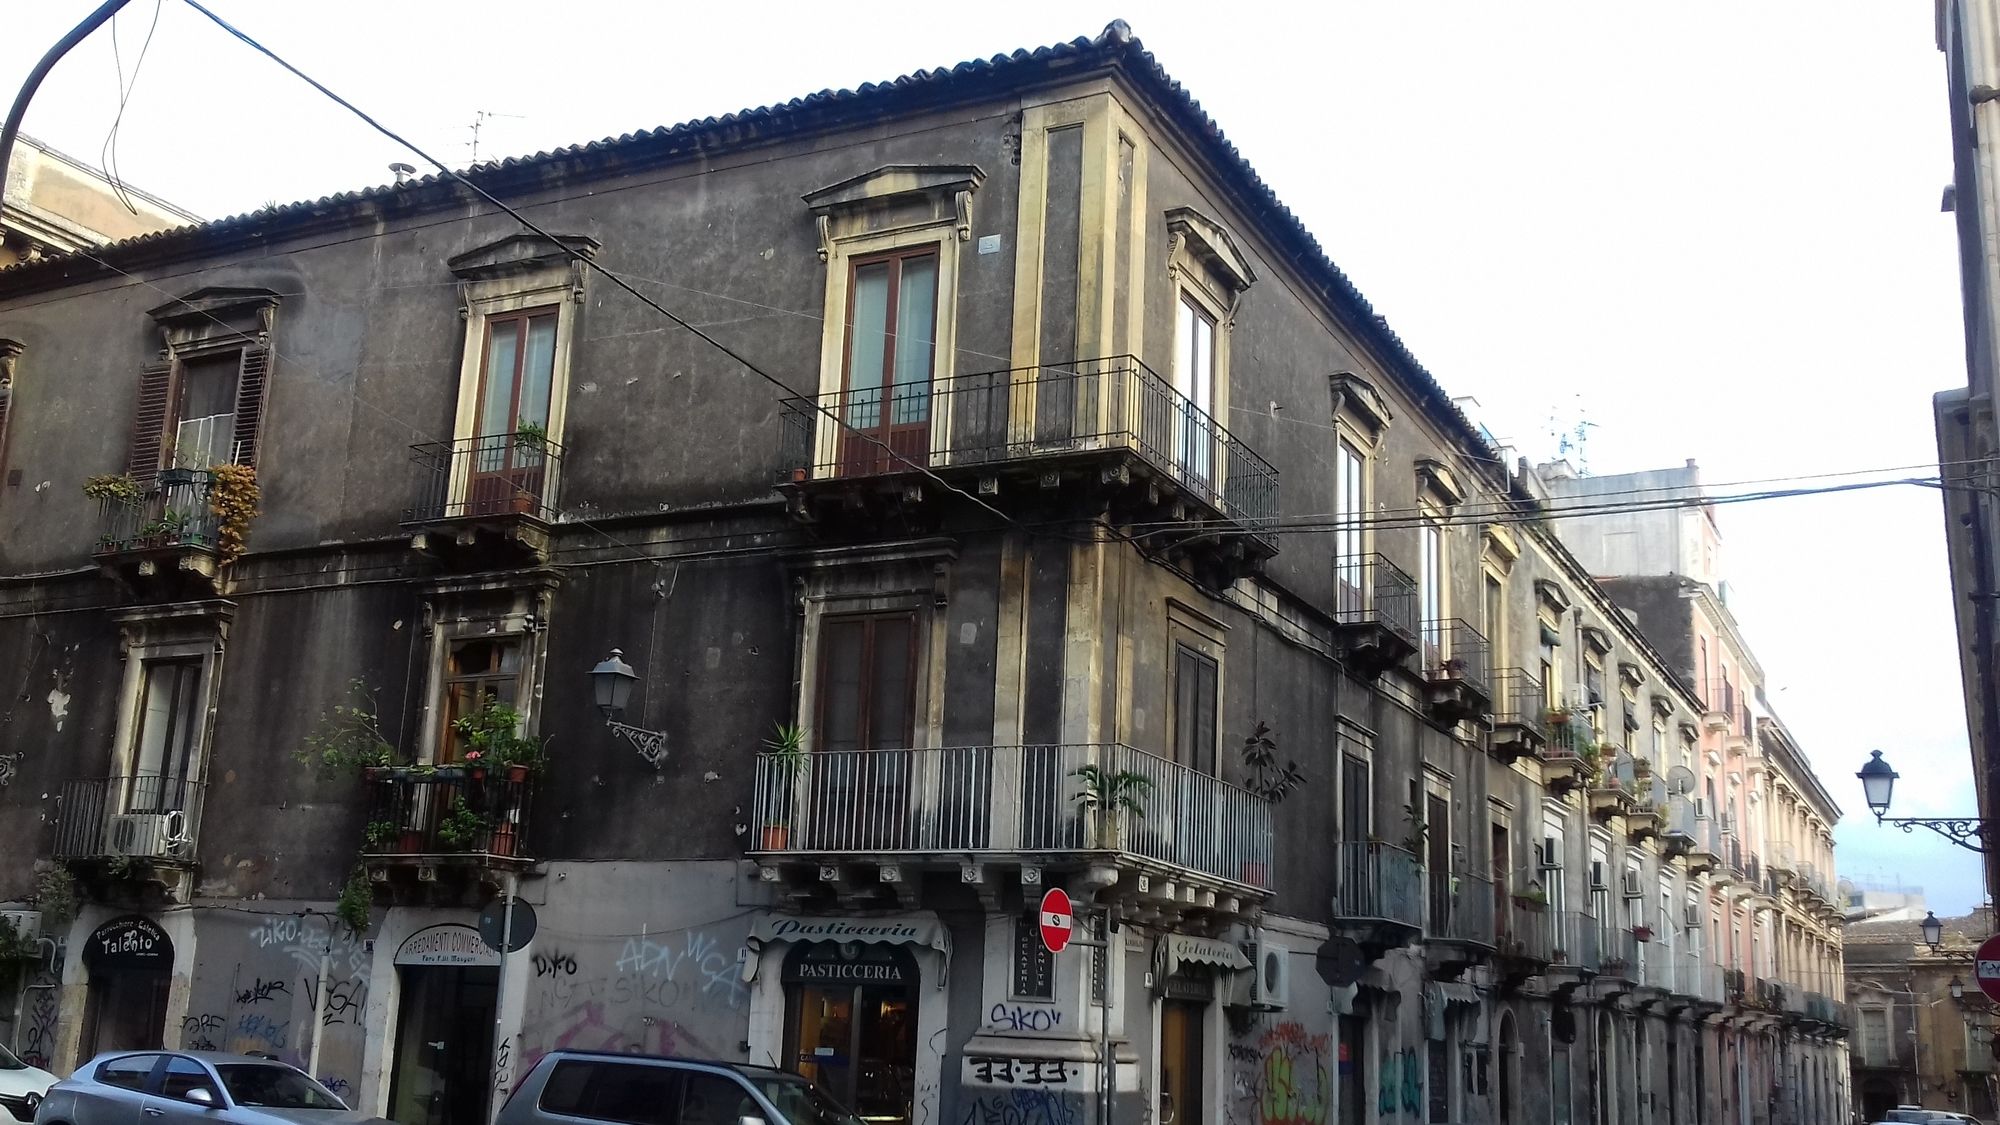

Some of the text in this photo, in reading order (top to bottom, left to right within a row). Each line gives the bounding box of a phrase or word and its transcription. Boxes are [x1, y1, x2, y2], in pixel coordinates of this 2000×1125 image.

[771, 919, 917, 937] Pasticceria
[102, 929, 153, 955] Talento
[1177, 941, 1233, 960] Gelateria
[800, 963, 902, 979] PASTICCERIA
[1020, 937, 1028, 994] GELATERIA
